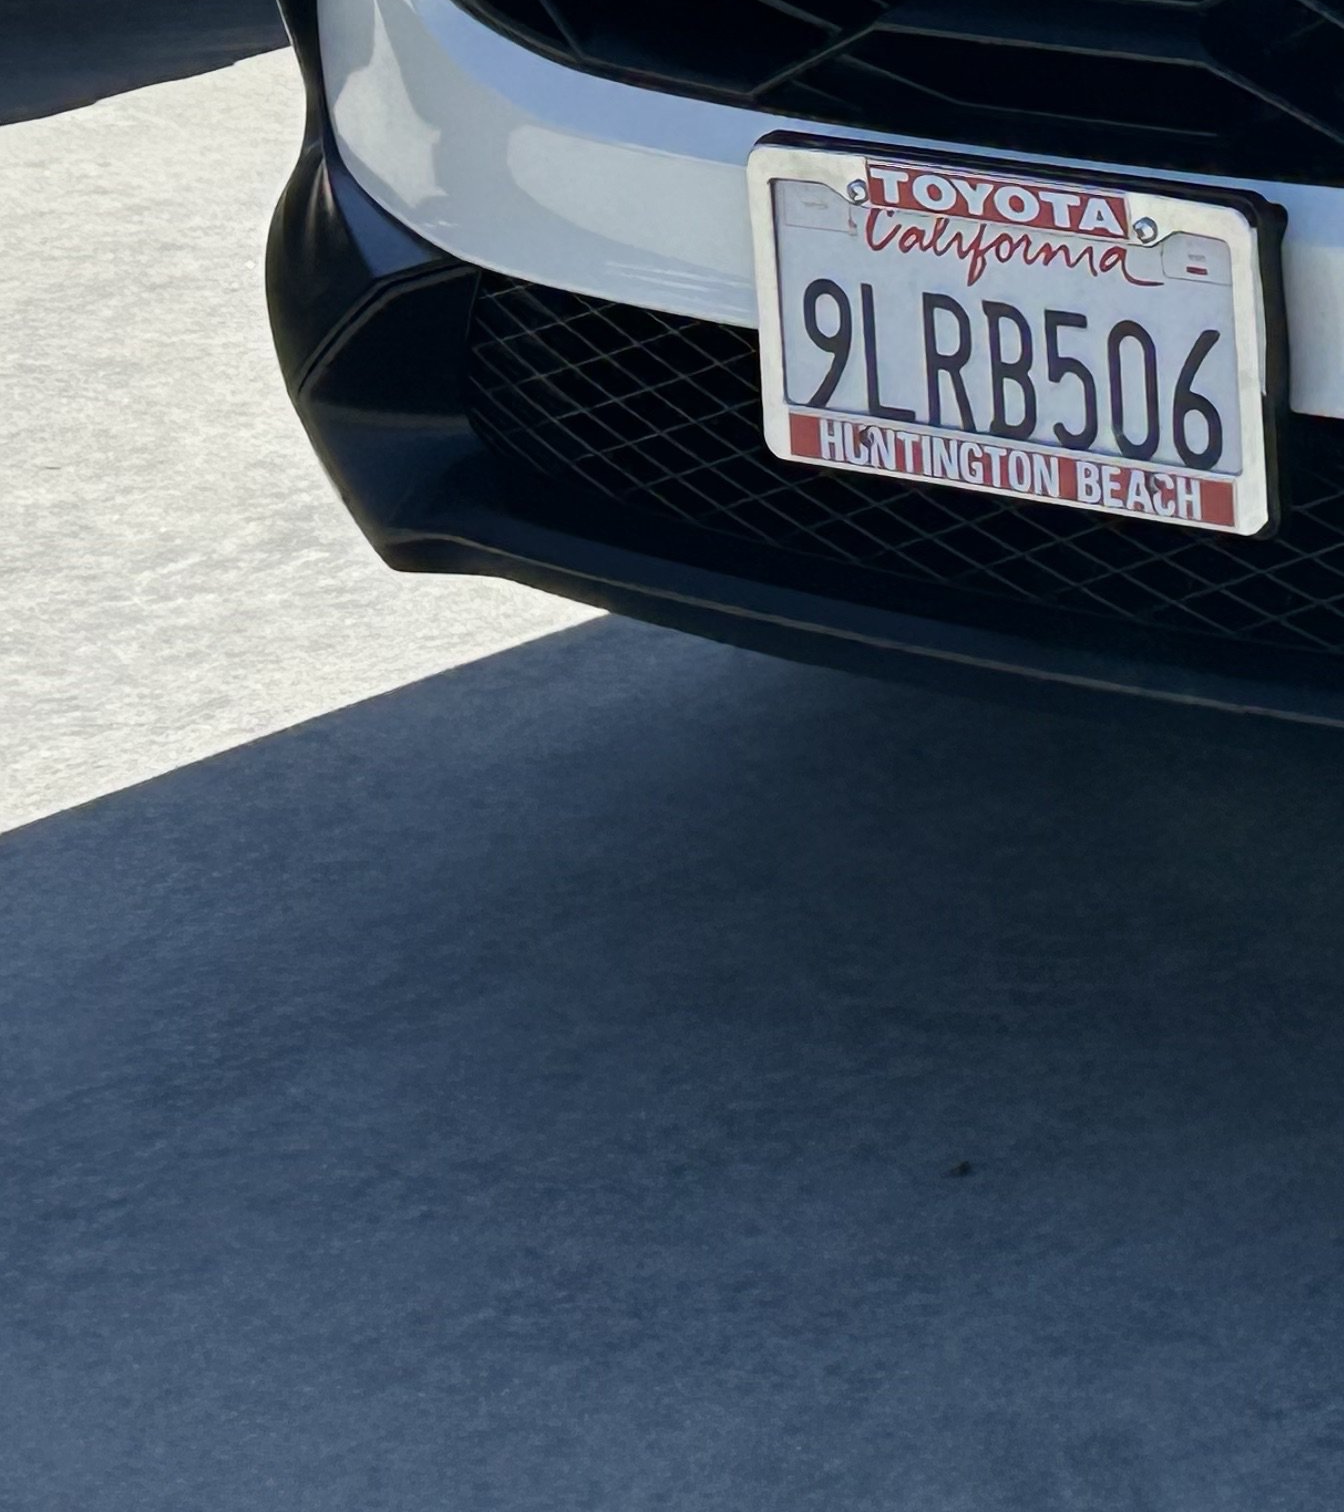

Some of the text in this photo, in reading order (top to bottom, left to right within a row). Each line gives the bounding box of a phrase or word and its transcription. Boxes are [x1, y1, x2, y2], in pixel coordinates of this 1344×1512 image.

[865, 208, 1164, 286] California
[870, 169, 1117, 236] TOYOTA
[803, 278, 1223, 472] 9LRB506
[819, 418, 1202, 521] HUNTINGTON BEACH
